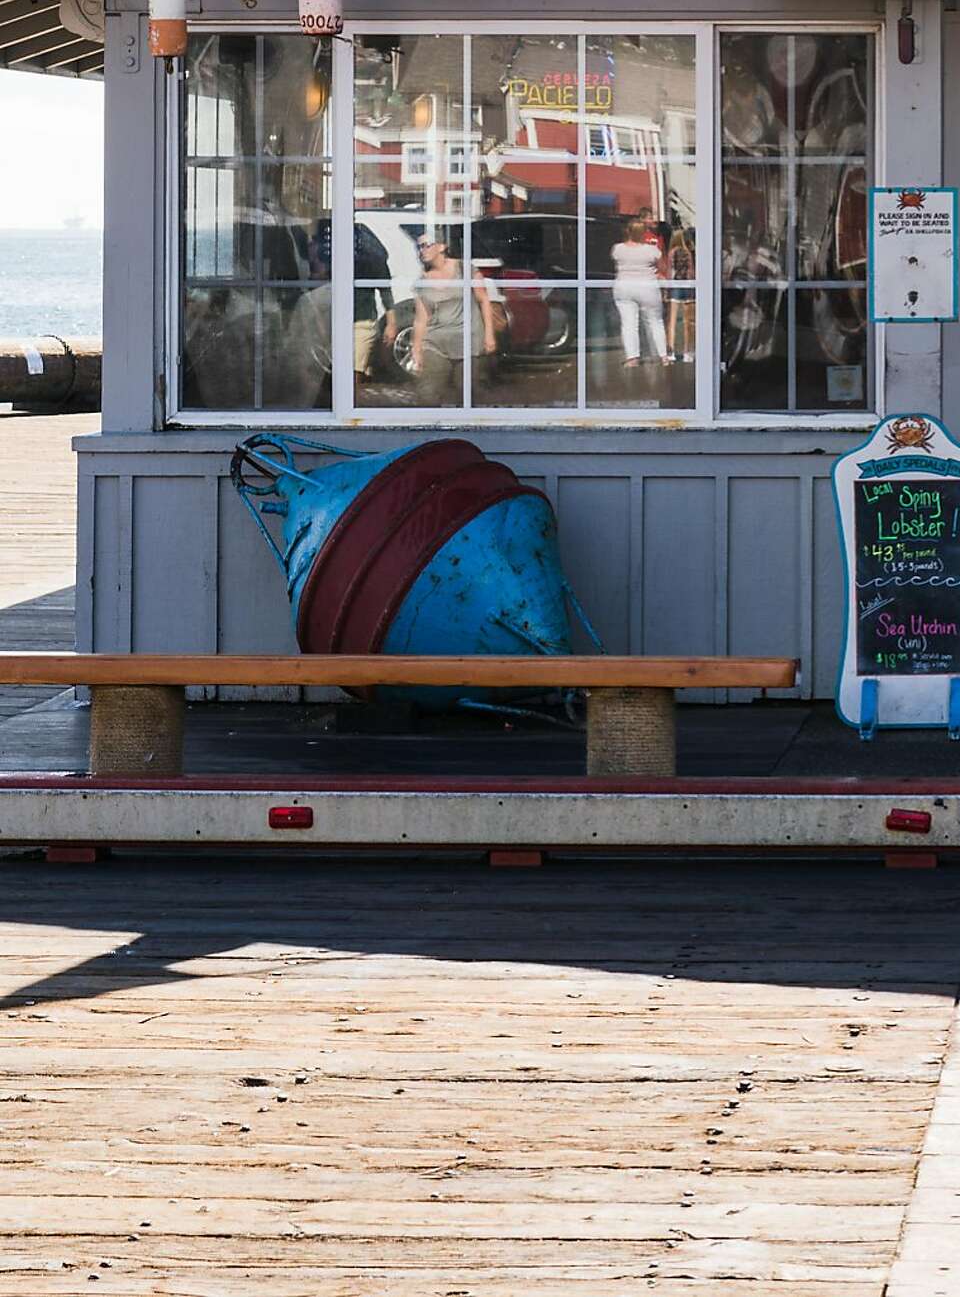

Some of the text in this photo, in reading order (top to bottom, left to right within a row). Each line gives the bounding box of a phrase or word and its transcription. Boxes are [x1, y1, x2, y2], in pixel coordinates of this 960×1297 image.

[509, 79, 611, 105] PACIFCO
[899, 486, 941, 518] Spiny
[877, 512, 945, 540] Lobster
[876, 613, 958, 638] Sea Urchin
